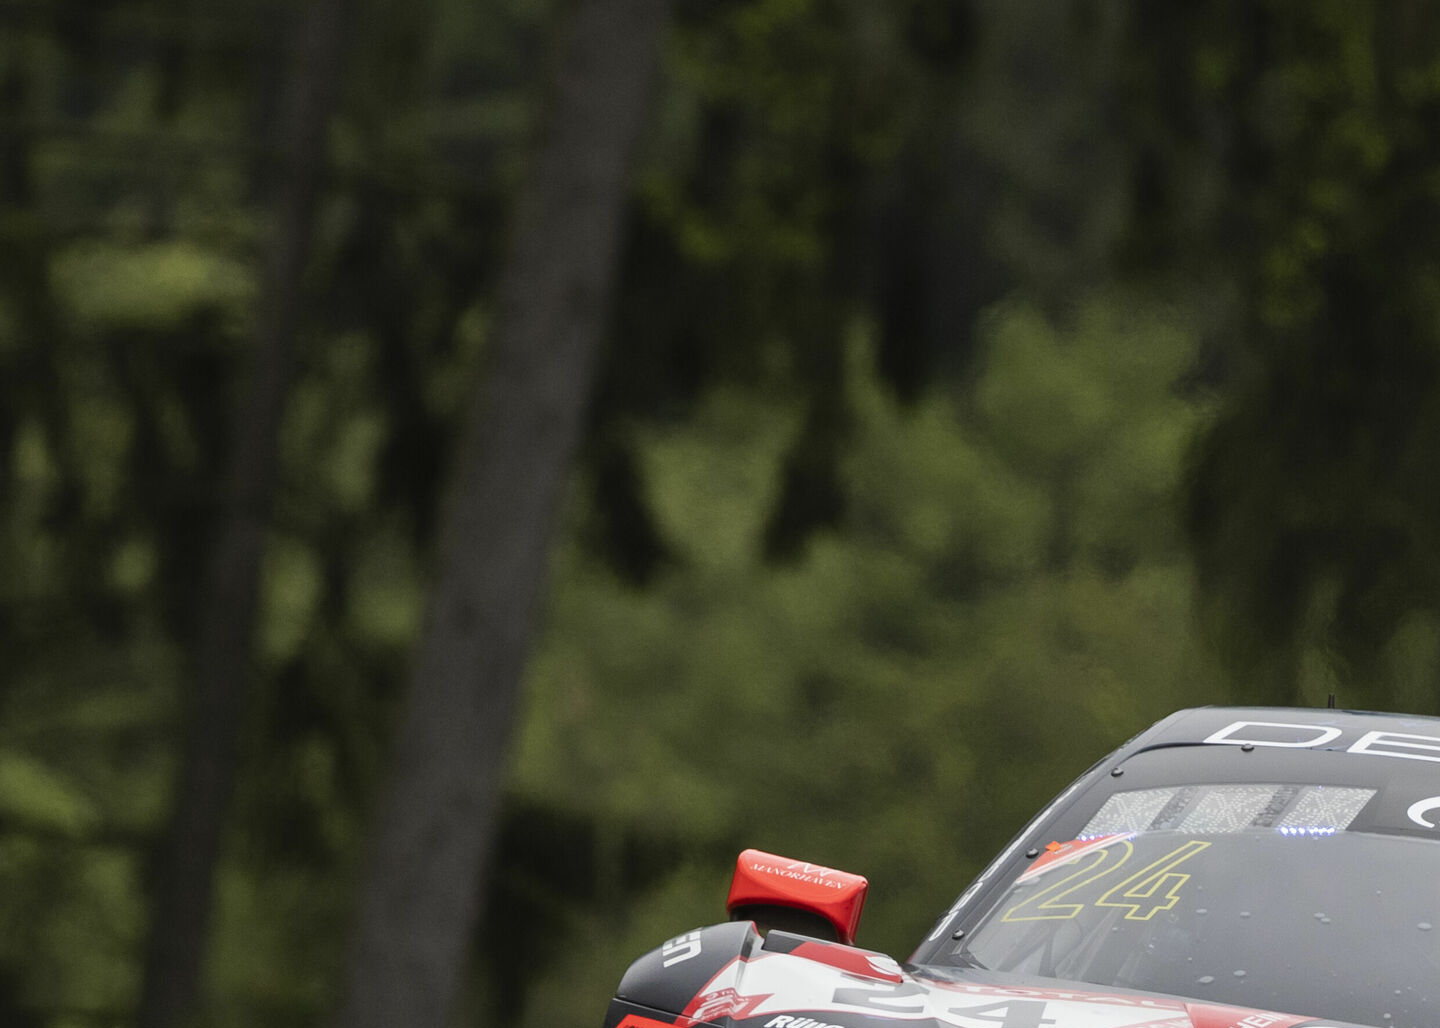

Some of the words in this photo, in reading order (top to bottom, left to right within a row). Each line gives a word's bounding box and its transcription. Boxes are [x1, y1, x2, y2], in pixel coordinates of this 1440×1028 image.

[749, 862, 847, 891] MANORHAVEN
[1001, 840, 1213, 922] 24
[965, 984, 1182, 1010] TOTAL
